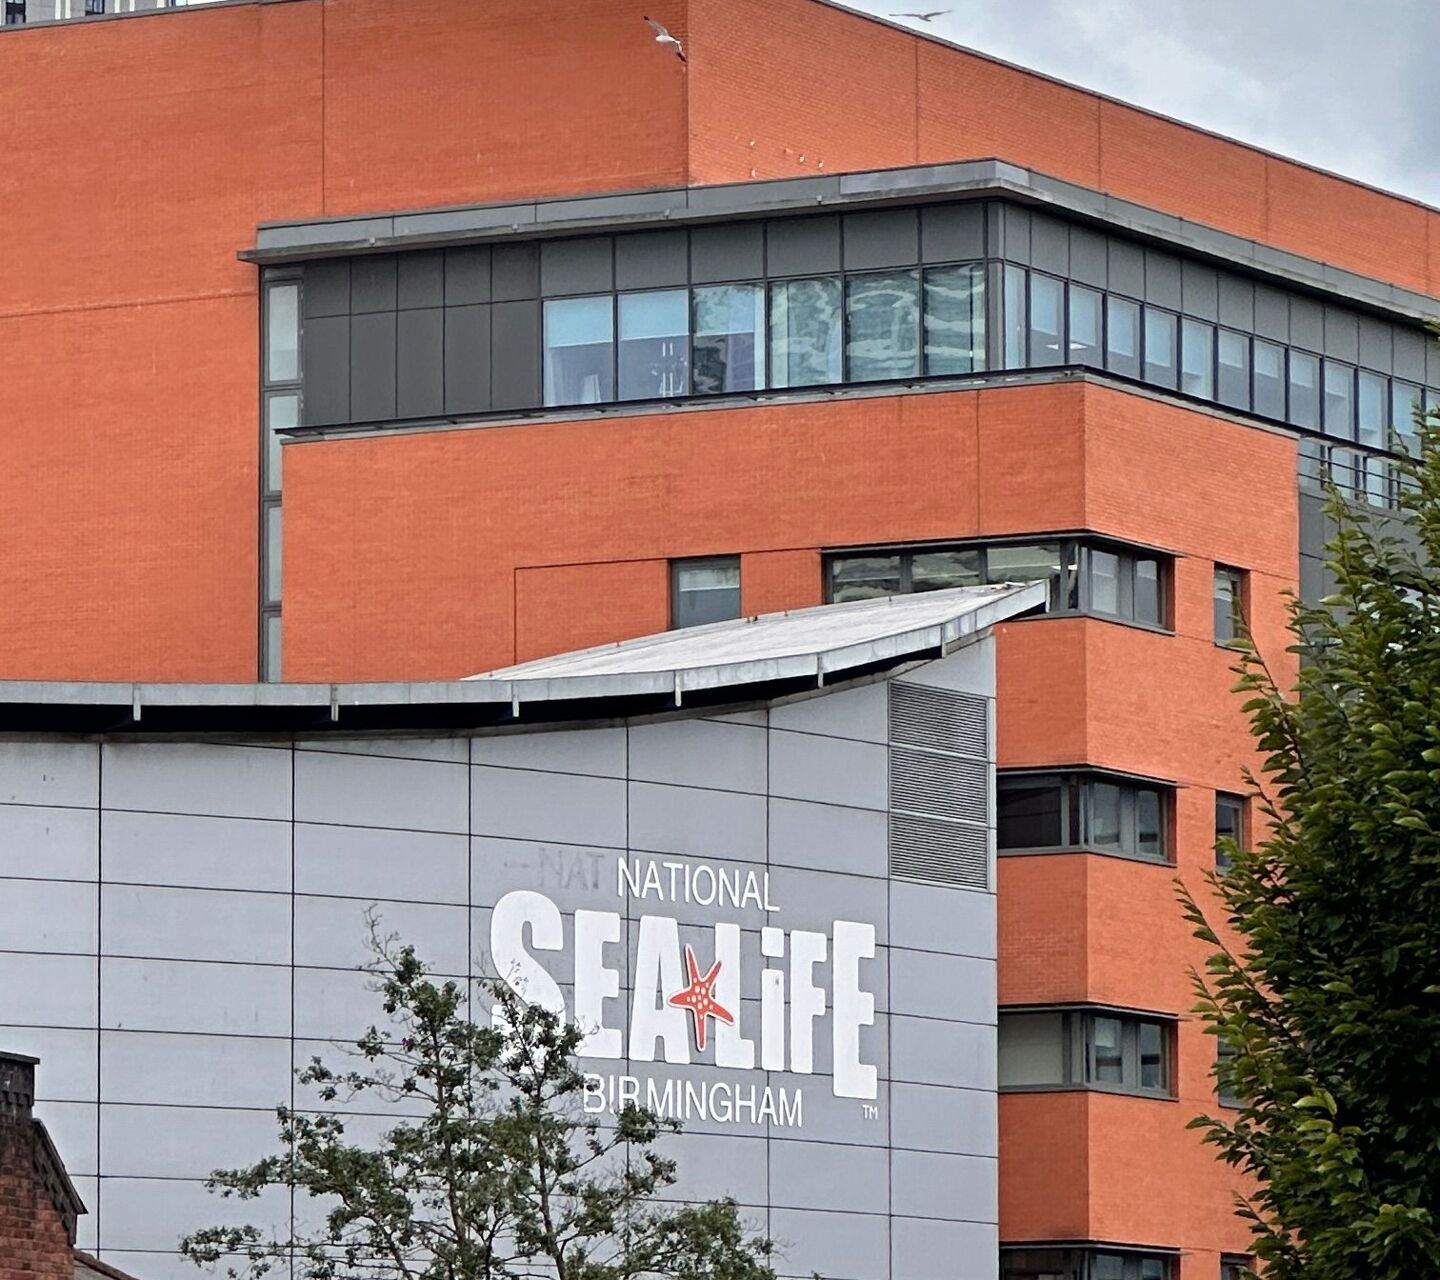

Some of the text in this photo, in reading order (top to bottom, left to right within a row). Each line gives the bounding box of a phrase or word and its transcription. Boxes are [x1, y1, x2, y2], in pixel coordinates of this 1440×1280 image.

[617, 856, 780, 912] NATIONAL
[582, 1072, 803, 1128] BIRMINGHAM
[862, 1104, 879, 1120] TM
